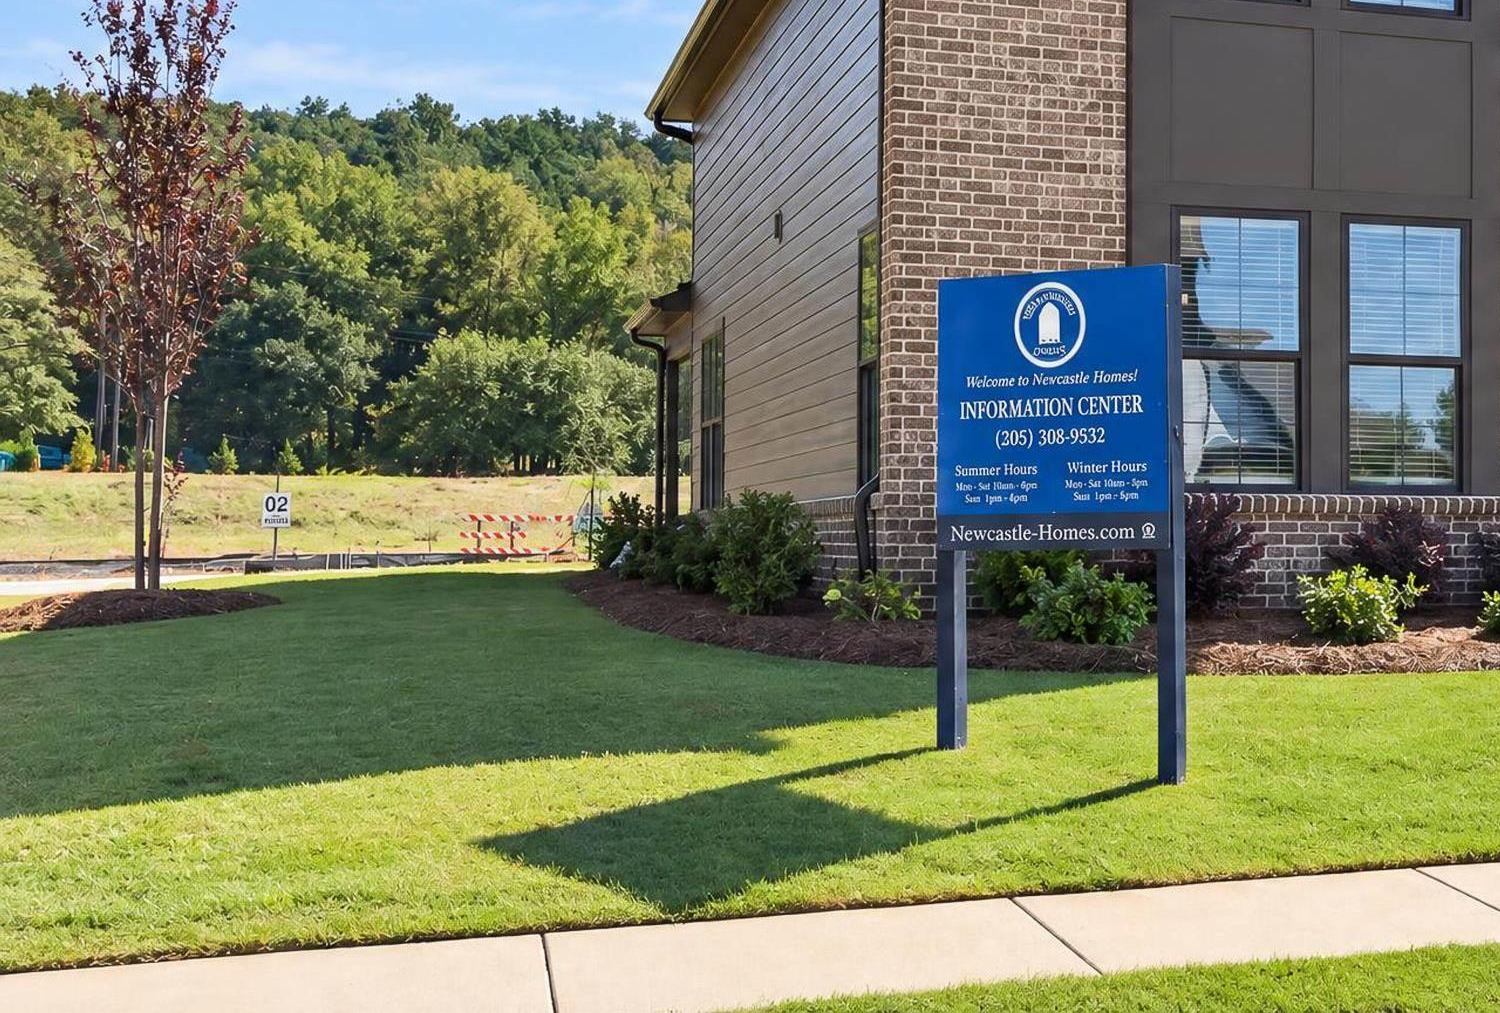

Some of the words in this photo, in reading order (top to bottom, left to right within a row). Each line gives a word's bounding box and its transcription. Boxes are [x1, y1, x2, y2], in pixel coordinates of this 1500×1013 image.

[966, 375, 1014, 389] Welcome
[1017, 375, 1029, 387] to
[1032, 372, 1090, 386] Newcastle
[1093, 368, 1139, 384] Homes!
[959, 397, 1074, 420] INFORMATION
[1077, 394, 1144, 415] CENTER
[995, 428, 1034, 450] (205)
[1038, 427, 1105, 447] 308-9532
[955, 464, 1001, 477] Summer
[1004, 463, 1038, 476] Hours
[1067, 461, 1109, 474] Winter
[1111, 460, 1148, 473] Hours
[265, 495, 288, 513] 02
[950, 524, 1135, 542] Newcastle-Homes.com
